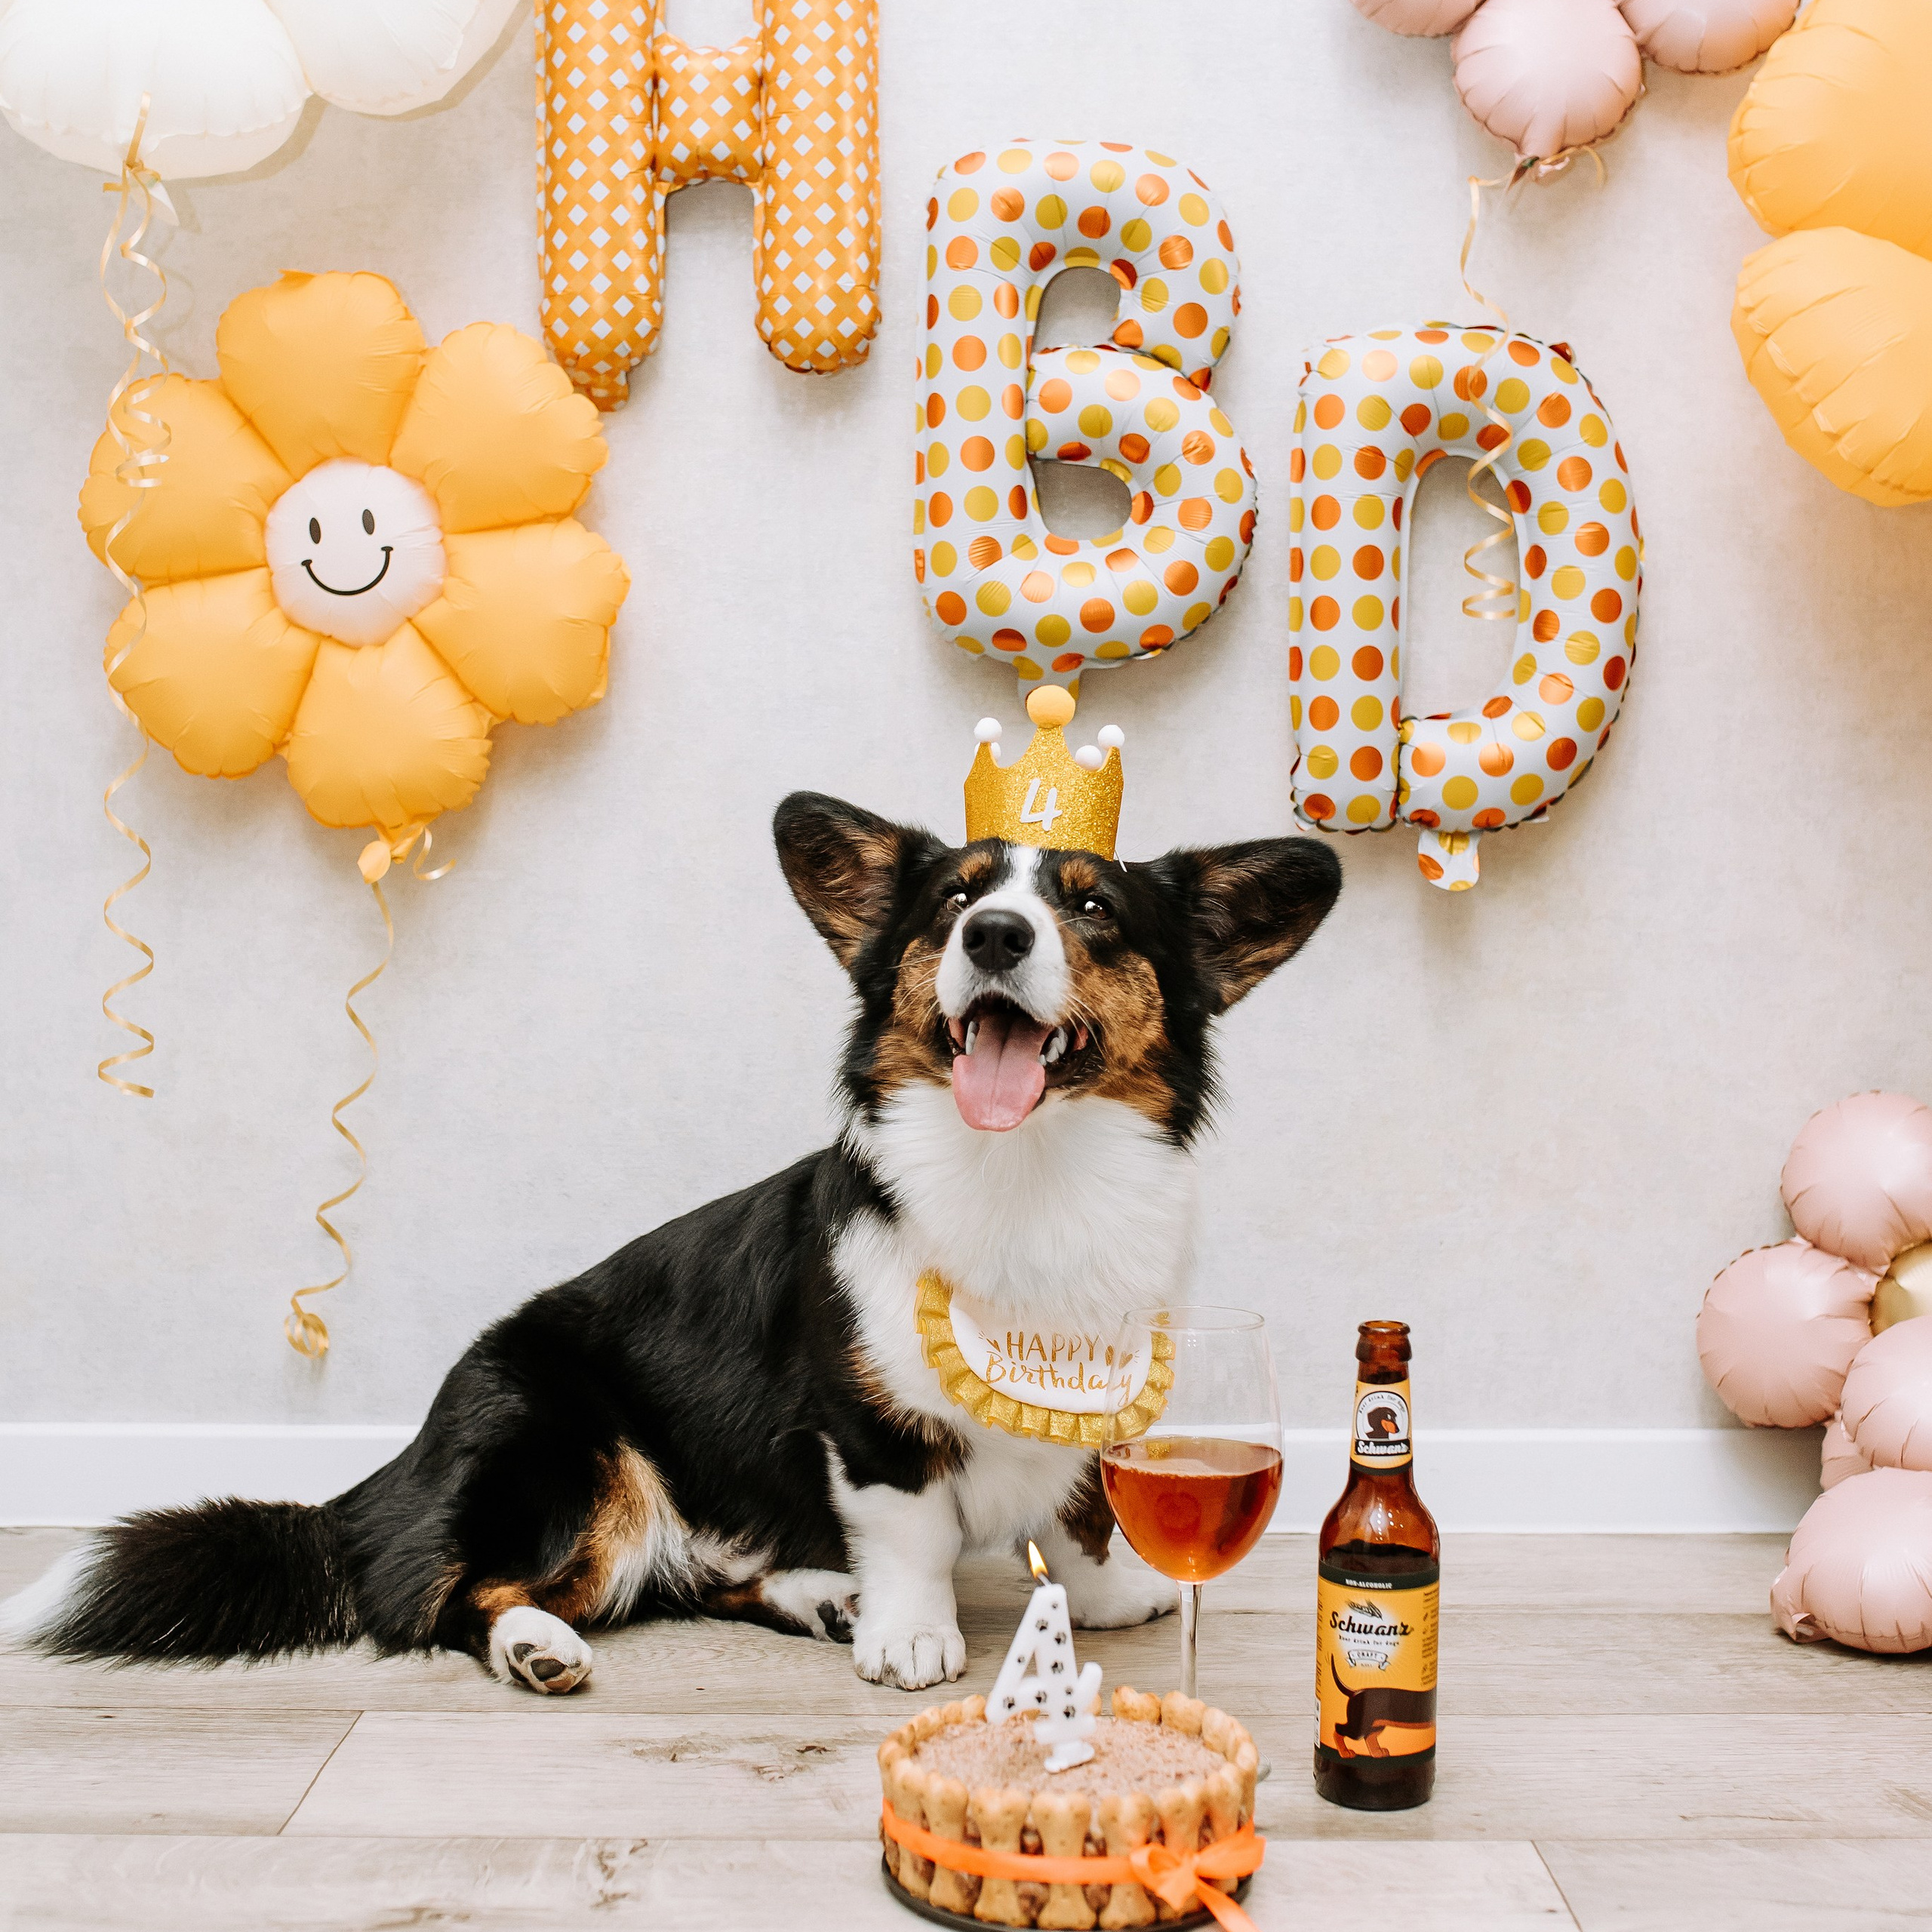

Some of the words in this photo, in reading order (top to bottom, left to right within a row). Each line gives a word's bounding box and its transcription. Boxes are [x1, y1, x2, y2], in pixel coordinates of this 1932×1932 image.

[1020, 777, 1063, 832] 4
[1006, 1331, 1100, 1362] HAPPY
[983, 1349, 1134, 1407] Birthday
[1330, 1611, 1414, 1636] Schwanz
[985, 1583, 1103, 1773] 4
